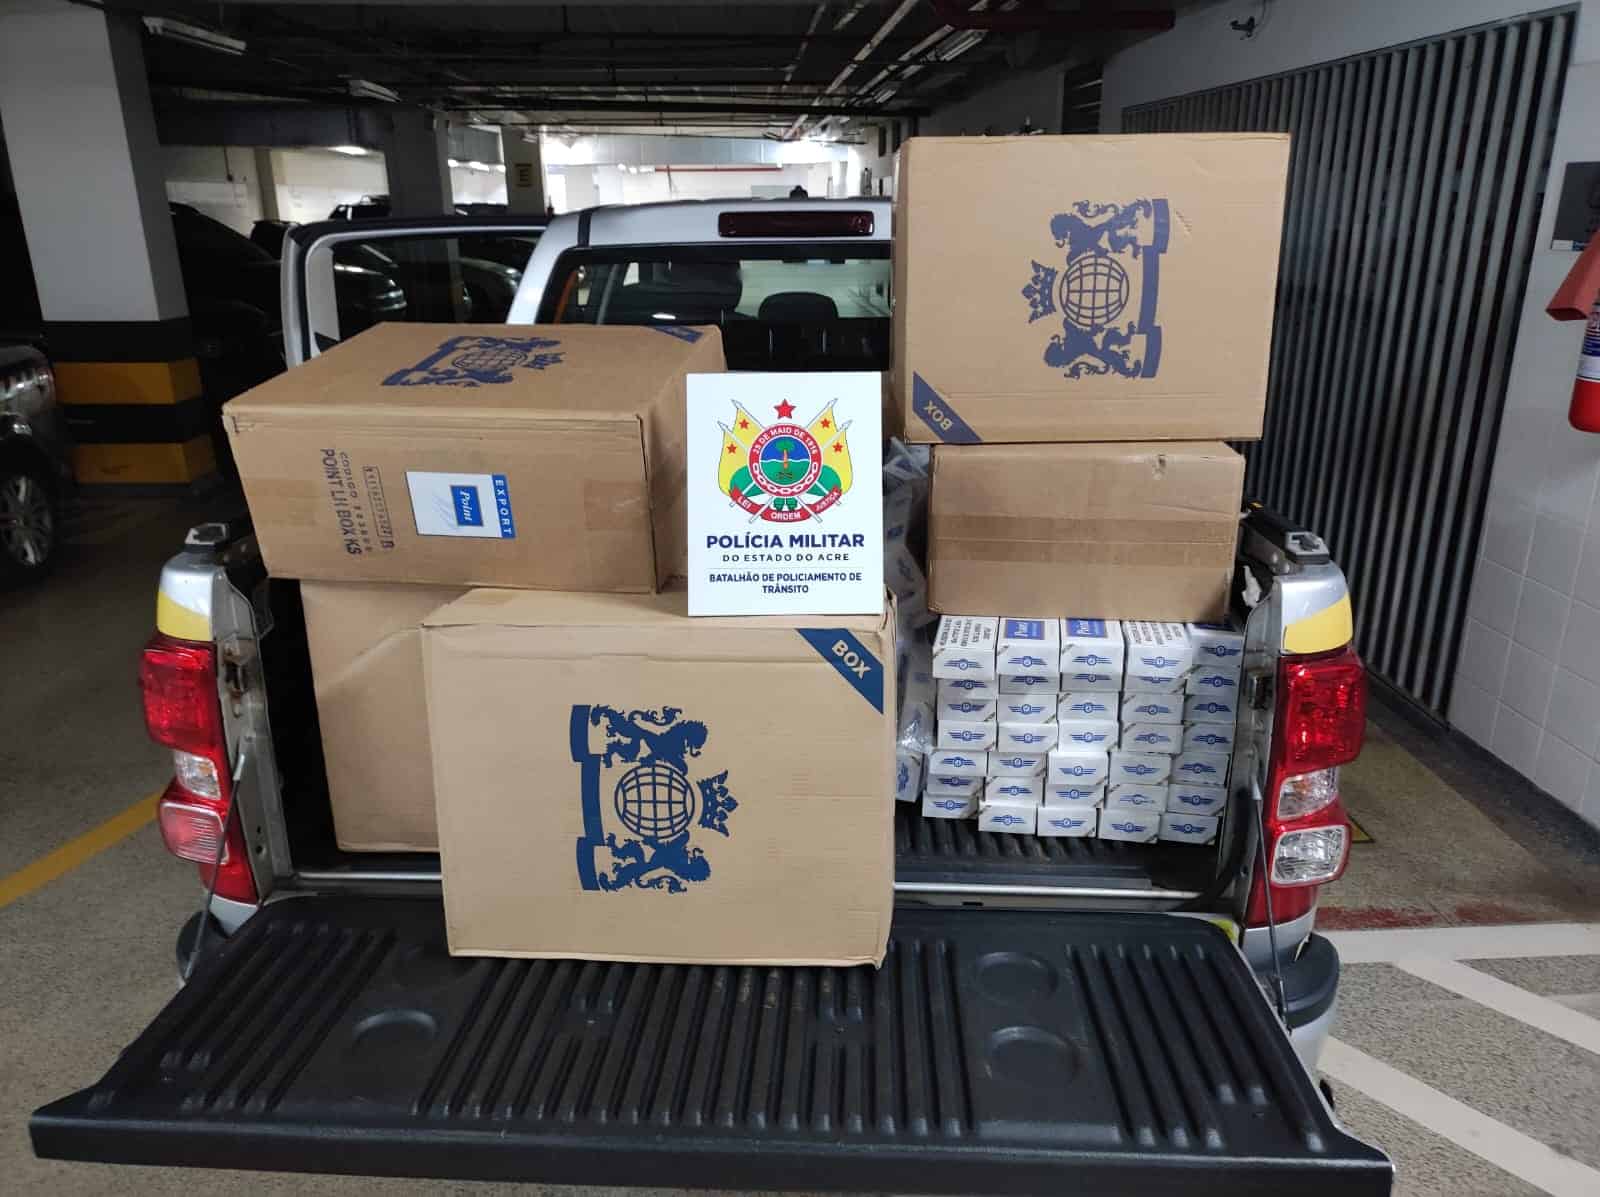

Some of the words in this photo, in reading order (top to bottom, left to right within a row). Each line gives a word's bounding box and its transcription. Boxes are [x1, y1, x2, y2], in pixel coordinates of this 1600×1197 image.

[923, 400, 954, 431] BOX
[758, 432, 771, 445] DE
[770, 426, 792, 436] MAIO
[793, 429, 806, 439] DE
[320, 448, 344, 487] POINT
[460, 489, 473, 522] Point
[495, 478, 512, 536] EXPORT
[737, 495, 753, 510] LEI
[770, 511, 802, 521] ORDEM
[706, 531, 783, 548] POLÍCIA
[789, 534, 865, 548] MILITAR
[722, 554, 740, 562] DO
[744, 554, 792, 562] ESTADO
[796, 553, 813, 561] DO
[818, 553, 849, 561] ACRE
[709, 571, 760, 583] BATALHÃO
[762, 573, 774, 582] DE
[777, 572, 847, 582] POLICIAMENTO
[849, 572, 862, 581] DE
[762, 584, 809, 594] TRÂNSITO
[832, 640, 872, 680] BOX
